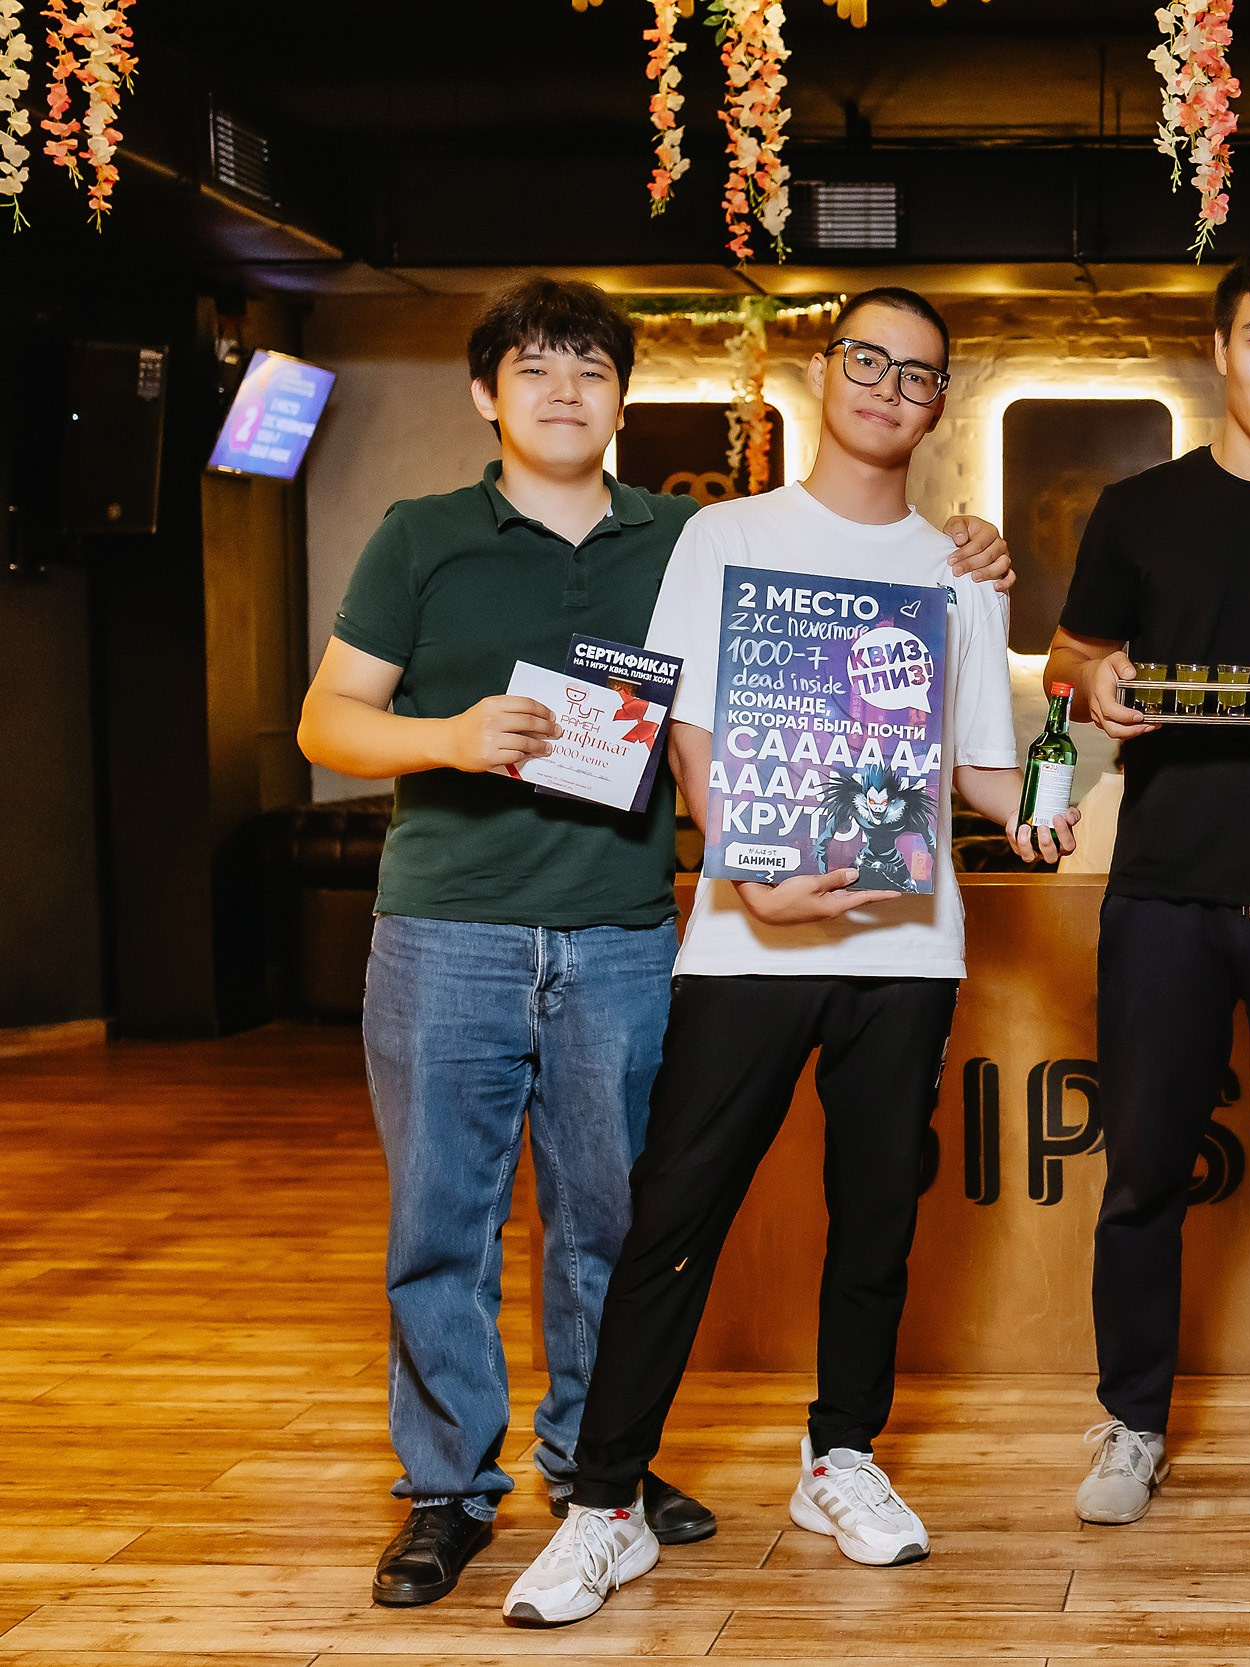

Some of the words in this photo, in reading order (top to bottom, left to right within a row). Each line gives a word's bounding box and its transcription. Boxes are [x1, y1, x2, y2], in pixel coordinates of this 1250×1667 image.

[235, 405, 258, 443] 2
[737, 583, 756, 608] 2
[766, 585, 879, 620] МЕСТО
[788, 616, 870, 641] nevermore
[575, 643, 678, 677] СЕРТИФИКАТ
[727, 636, 829, 670] 1000-7
[573, 657, 584, 666] НА
[590, 661, 609, 671] ИГРУ
[609, 666, 630, 677] КВИЗ,
[630, 670, 652, 681] ПЛИЗ!
[653, 676, 674, 686] ХОУМ
[732, 667, 785, 690] dead
[790, 672, 846, 695] inside
[851, 663, 932, 695] ПЛИЗ!
[567, 700, 605, 722] ТУТ
[728, 690, 832, 716] КОМАНДЕ,
[561, 715, 600, 733] РАМЕН
[727, 710, 809, 728] КОТОРАЯ
[813, 718, 863, 735] БЫЛА
[867, 723, 926, 741] ПОЧТИ
[561, 729, 630, 757] тификат
[581, 756, 608, 768] тенге
[722, 800, 868, 843] КРУТО
[738, 854, 786, 868] [АНИМЕ]
